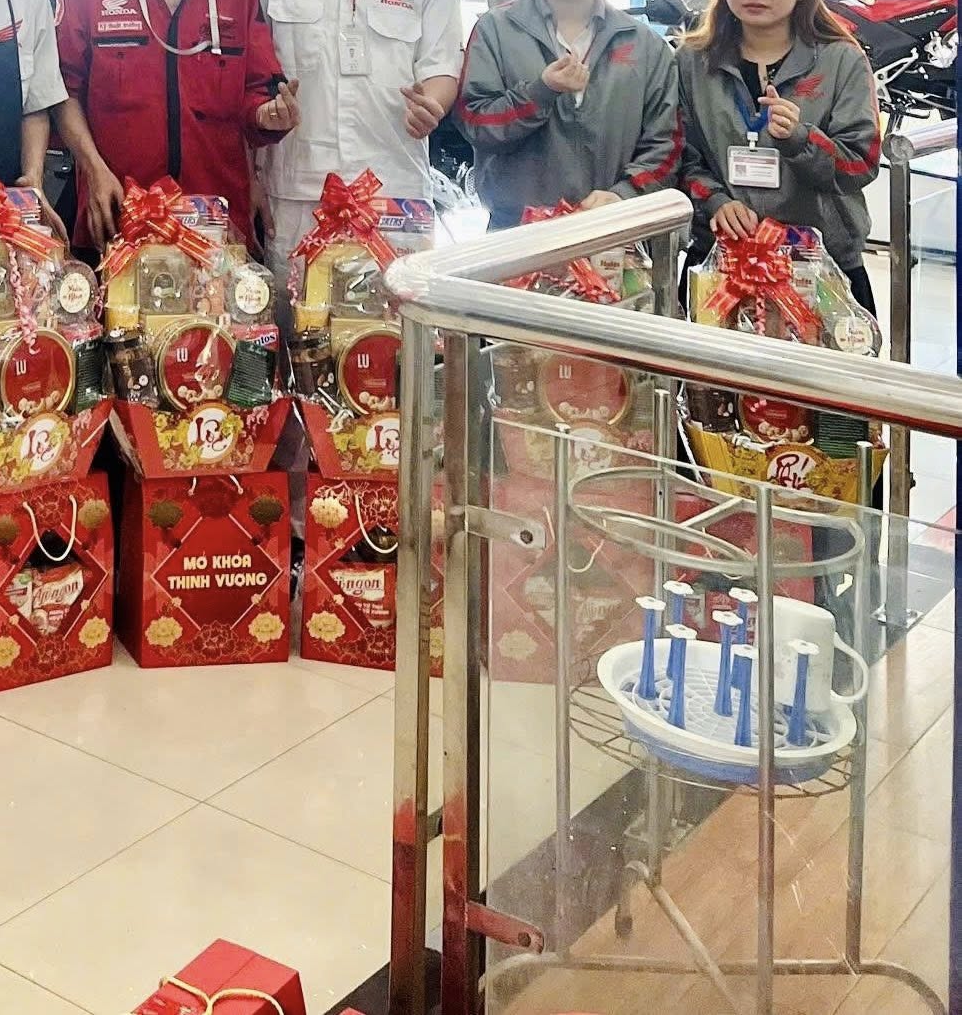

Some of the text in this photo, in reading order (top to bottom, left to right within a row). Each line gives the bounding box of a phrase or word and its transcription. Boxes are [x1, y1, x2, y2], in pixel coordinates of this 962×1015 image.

[101, 8, 138, 16] HONDA
[176, 347, 188, 363] LU
[357, 352, 370, 368] LU
[559, 364, 572, 379] LU
